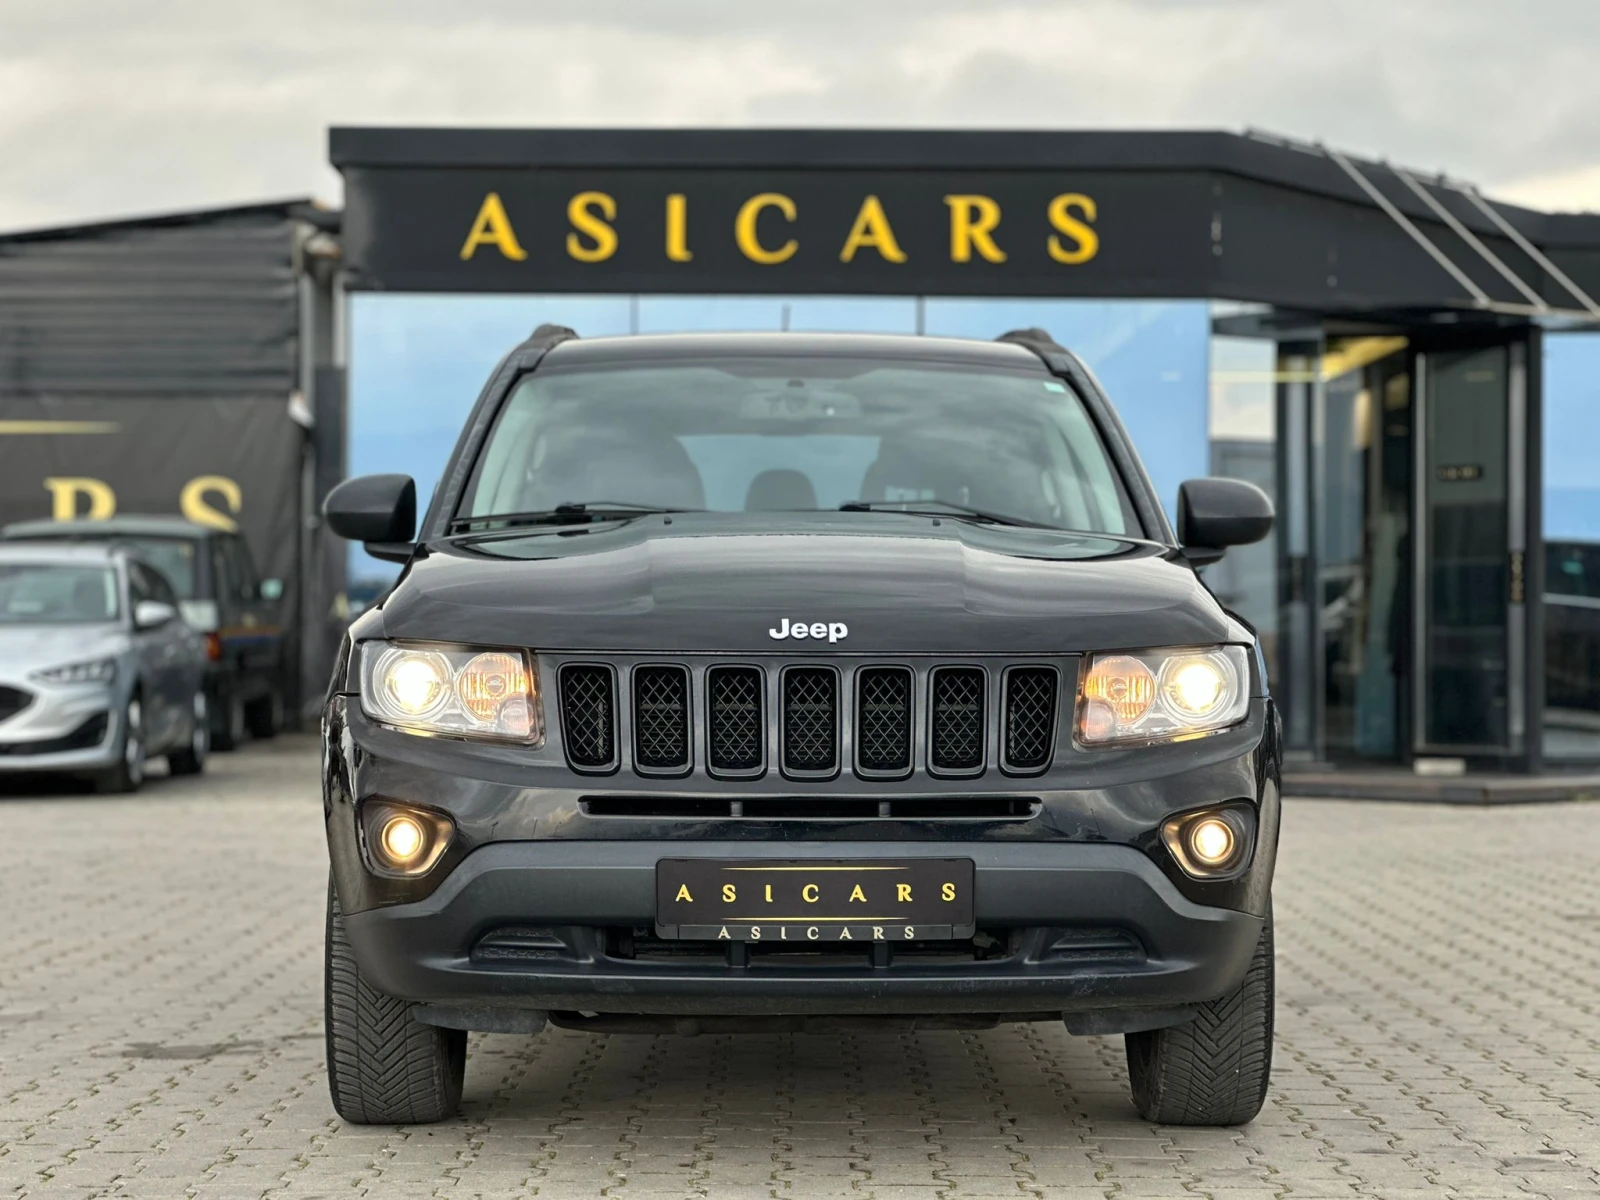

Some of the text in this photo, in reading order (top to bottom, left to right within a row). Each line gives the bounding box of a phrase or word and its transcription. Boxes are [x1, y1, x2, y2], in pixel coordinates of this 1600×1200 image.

[460, 191, 1100, 265] ASICARS
[769, 618, 849, 643] Jeep
[675, 882, 956, 903] ASICARS
[718, 926, 914, 940] ASICARS
